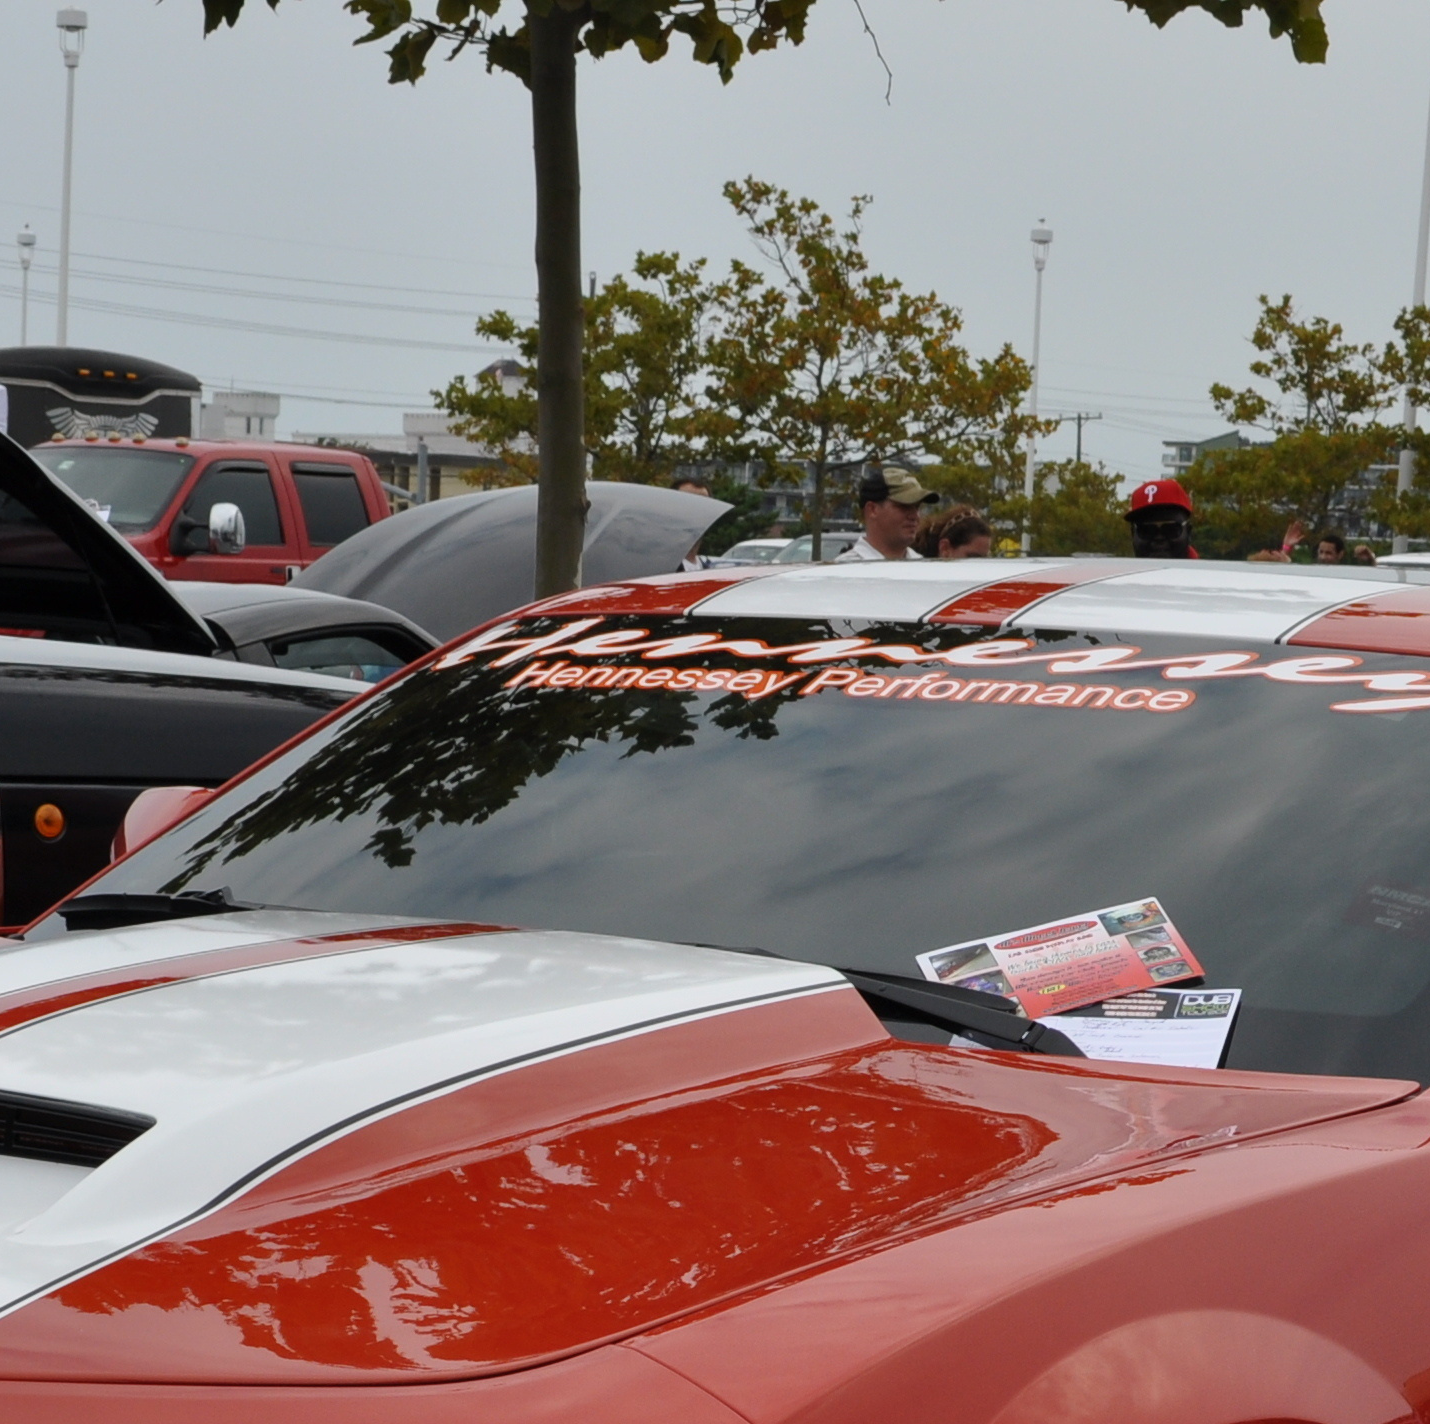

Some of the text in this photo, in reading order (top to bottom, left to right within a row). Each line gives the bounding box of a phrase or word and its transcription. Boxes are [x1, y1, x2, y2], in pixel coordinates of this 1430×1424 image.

[1144, 484, 1158, 503] P
[503, 660, 1197, 713] Hennessey Performance
[1183, 994, 1232, 1006] DUB
